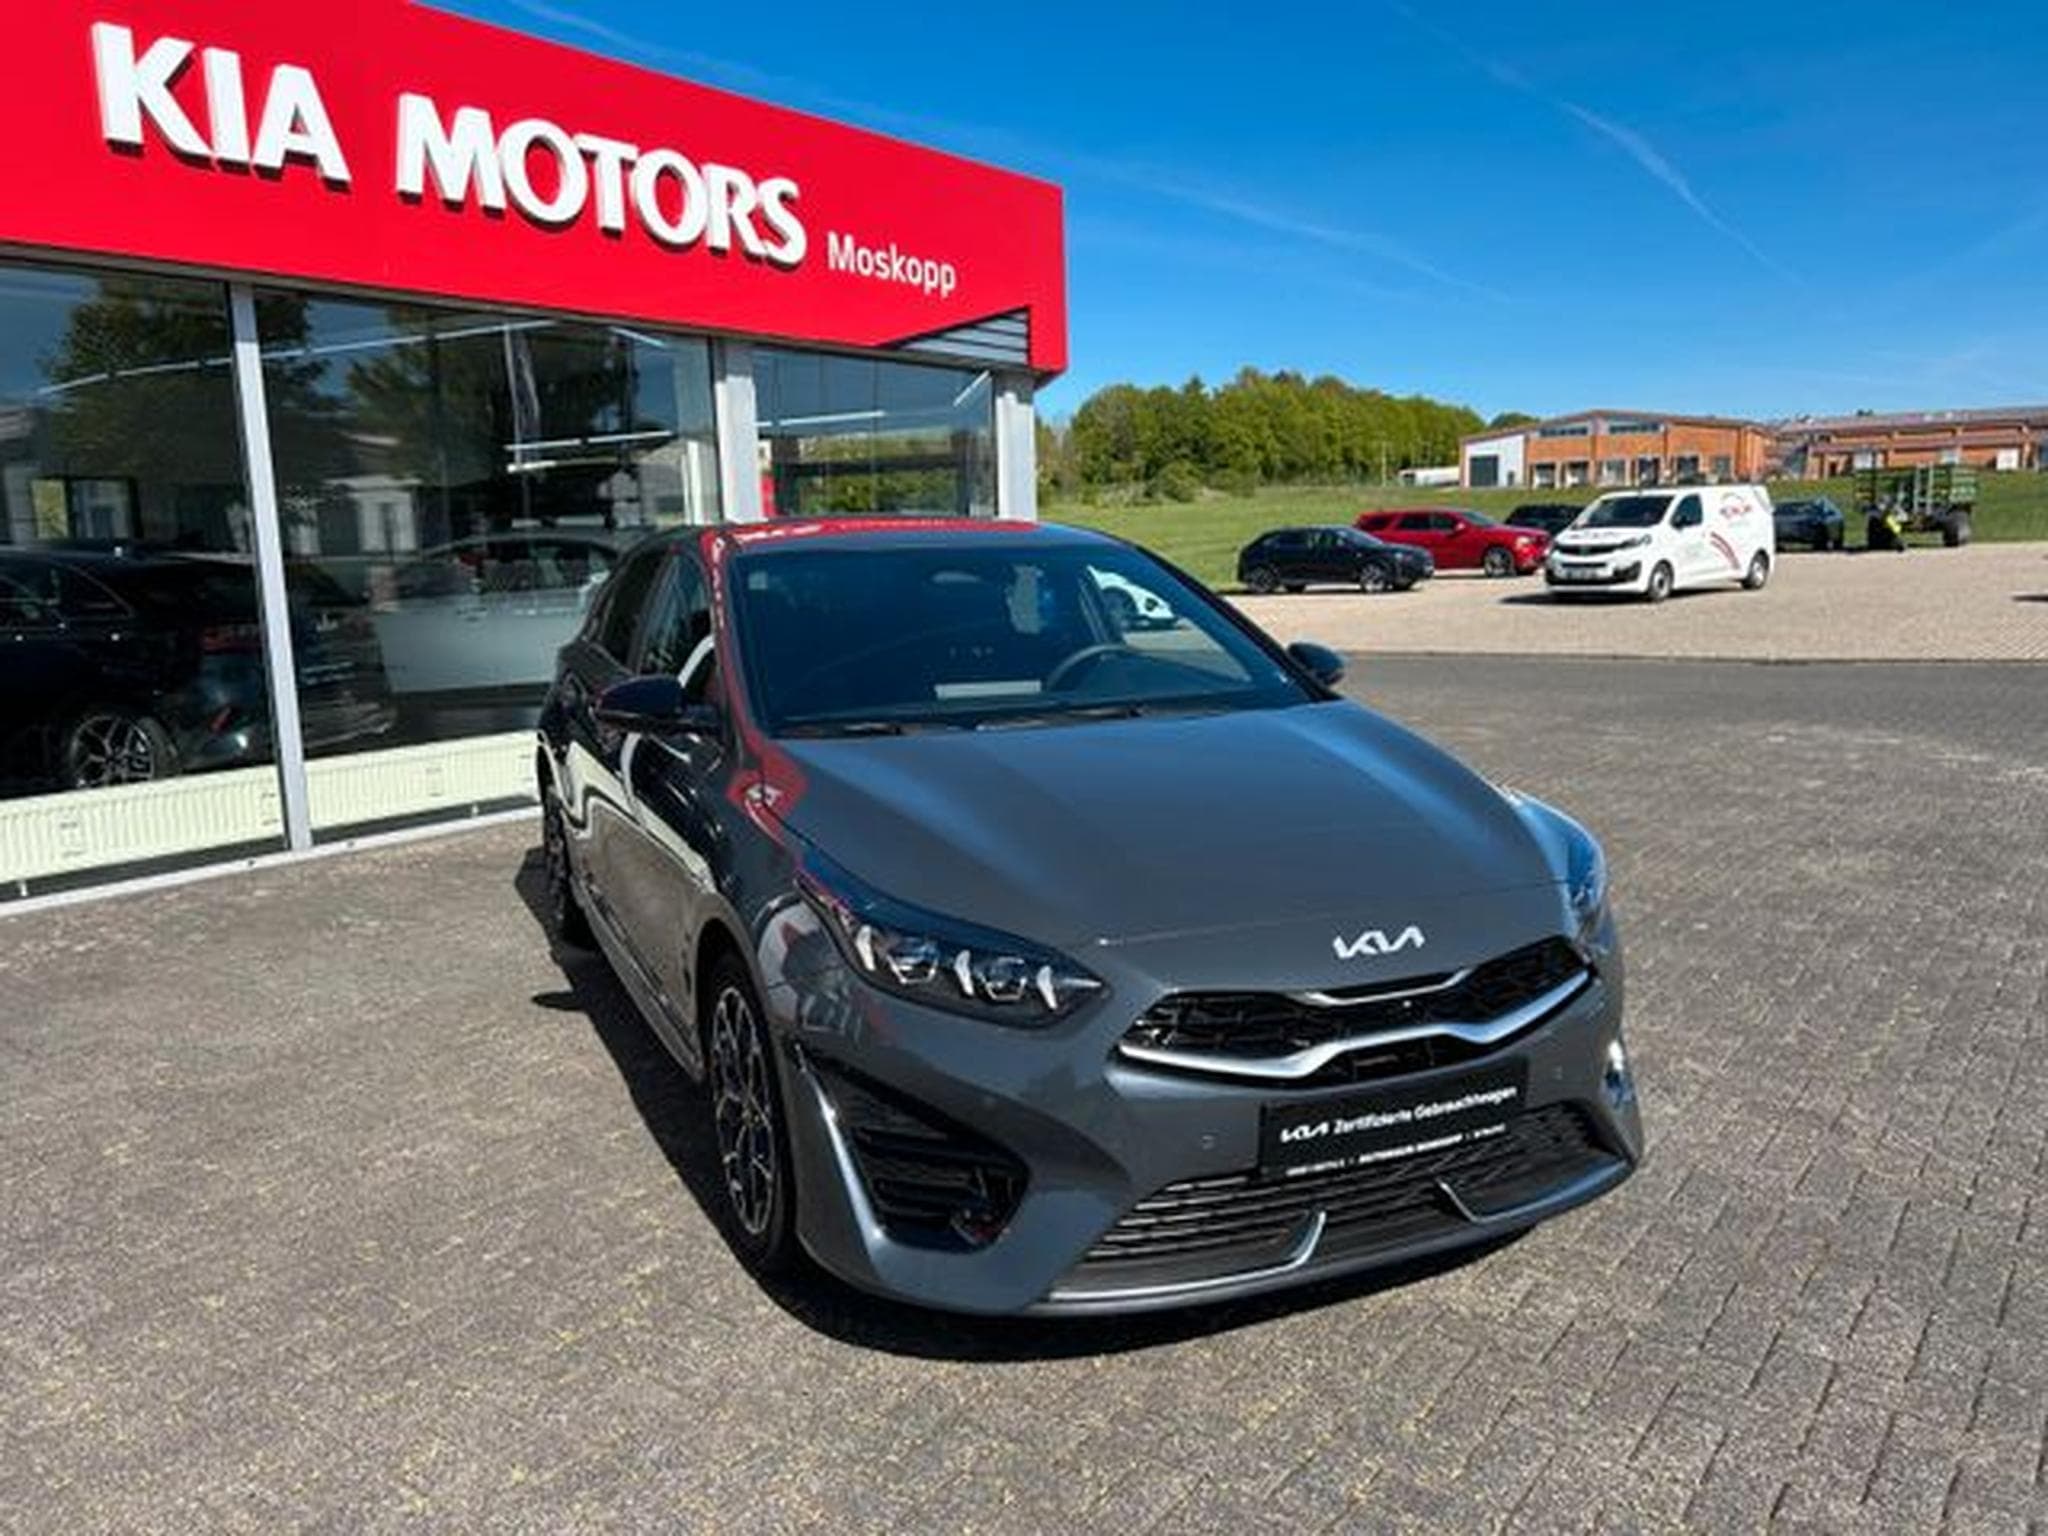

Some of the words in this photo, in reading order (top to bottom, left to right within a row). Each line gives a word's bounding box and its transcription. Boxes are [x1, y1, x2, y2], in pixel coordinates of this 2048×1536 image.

[92, 22, 351, 188] KIA
[397, 92, 807, 269] MOTORS
[827, 230, 957, 299] Moskopp
